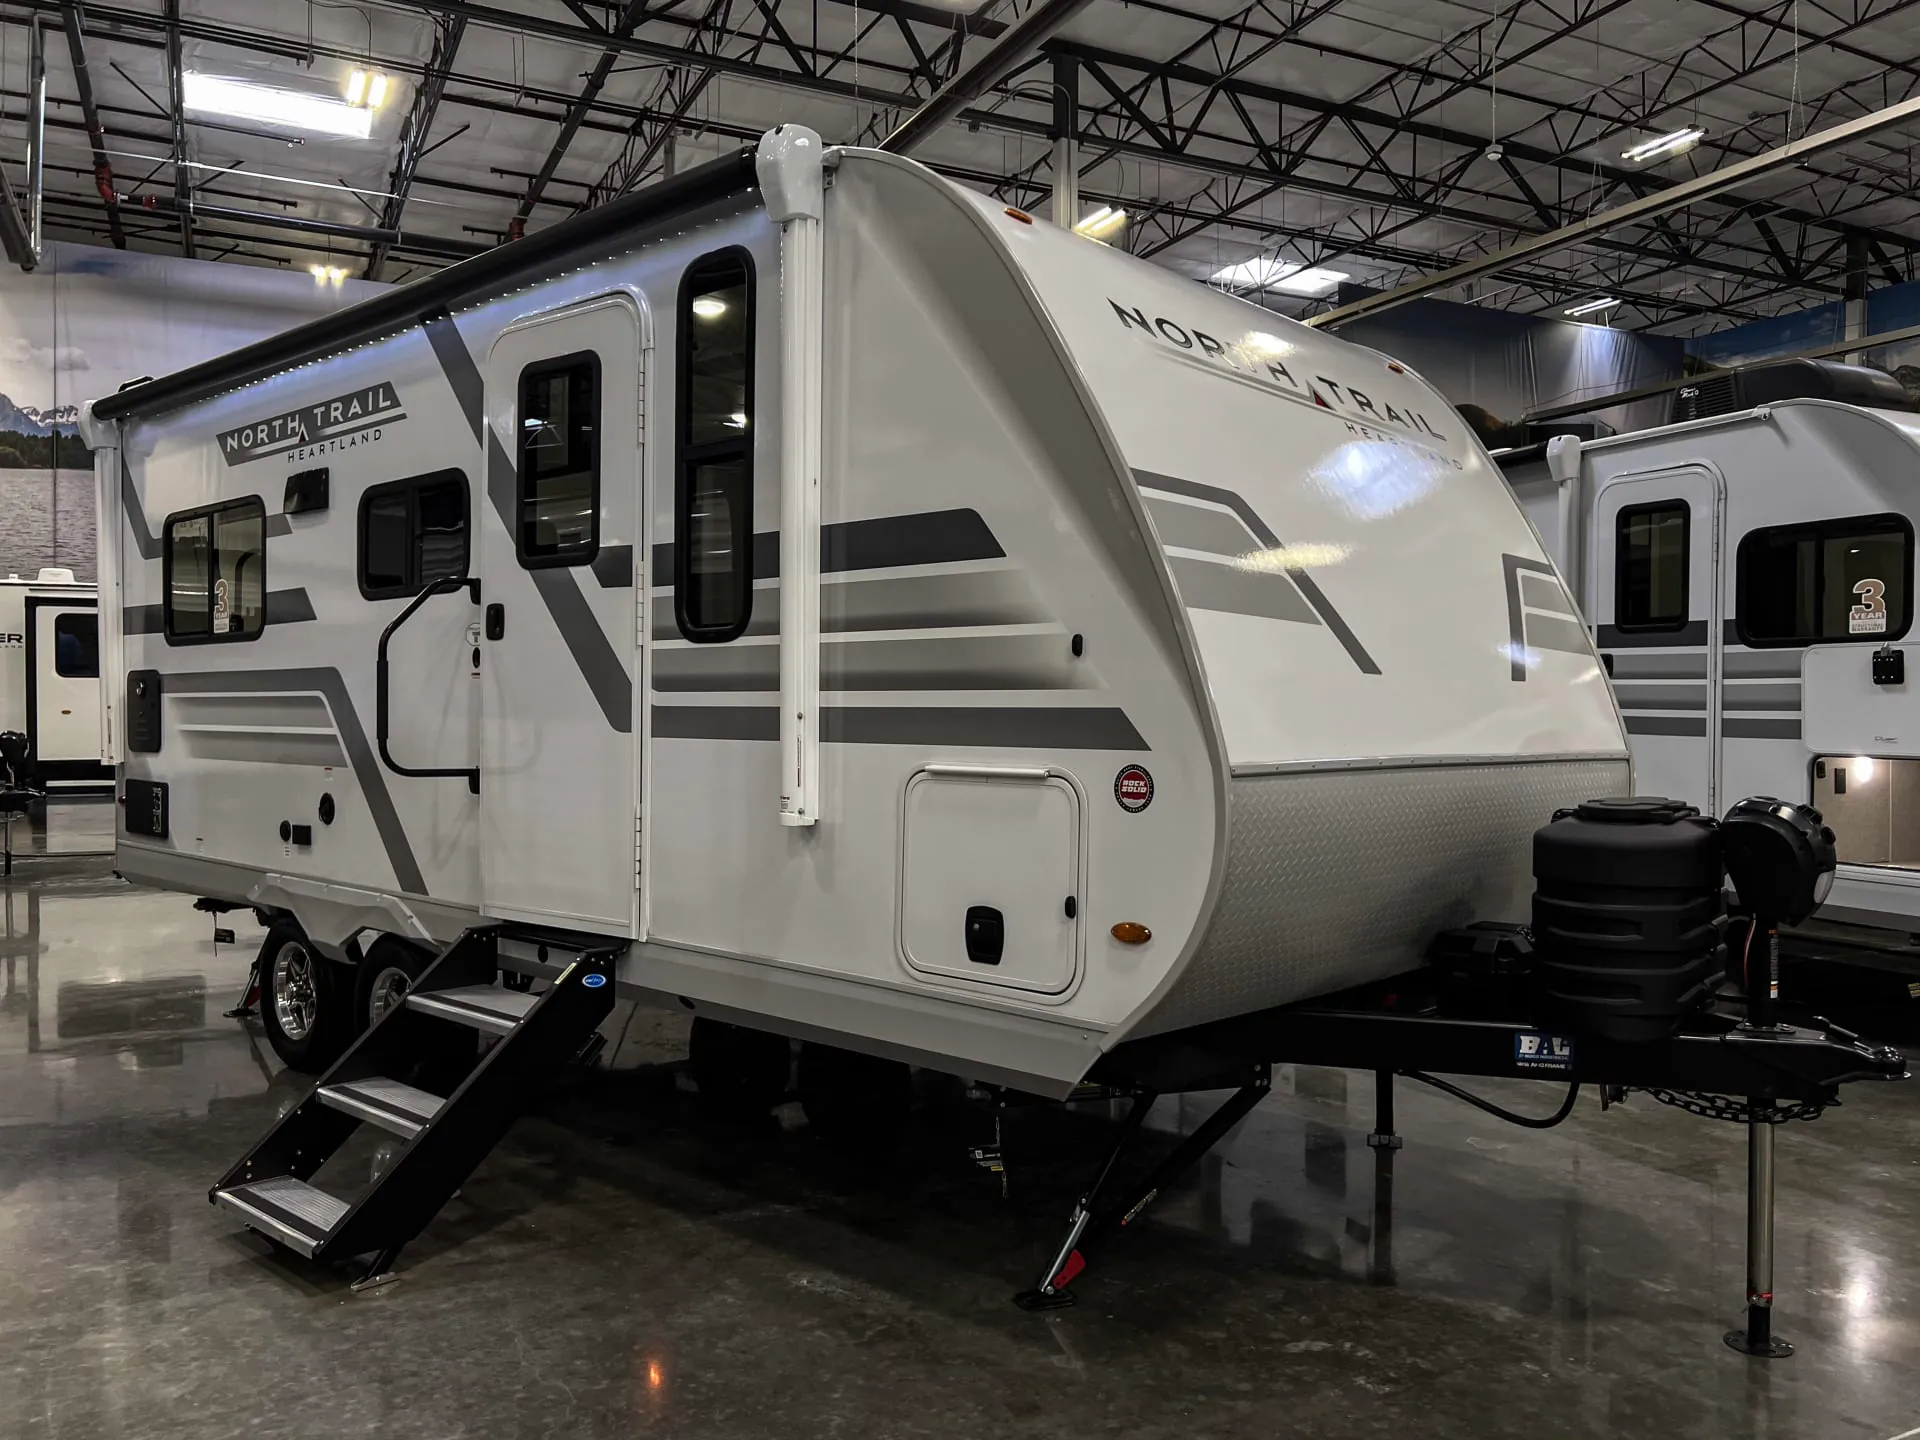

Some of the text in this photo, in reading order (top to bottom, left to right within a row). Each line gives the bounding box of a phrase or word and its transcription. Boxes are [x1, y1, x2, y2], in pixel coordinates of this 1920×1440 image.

[1106, 297, 1447, 442] NORH TRAIL
[226, 387, 392, 452] NORTH TRAIL
[287, 429, 382, 464] HEARTLAND
[214, 578, 229, 612] 3
[1852, 578, 1886, 612] 3
[1519, 1035, 1570, 1055] BAL
